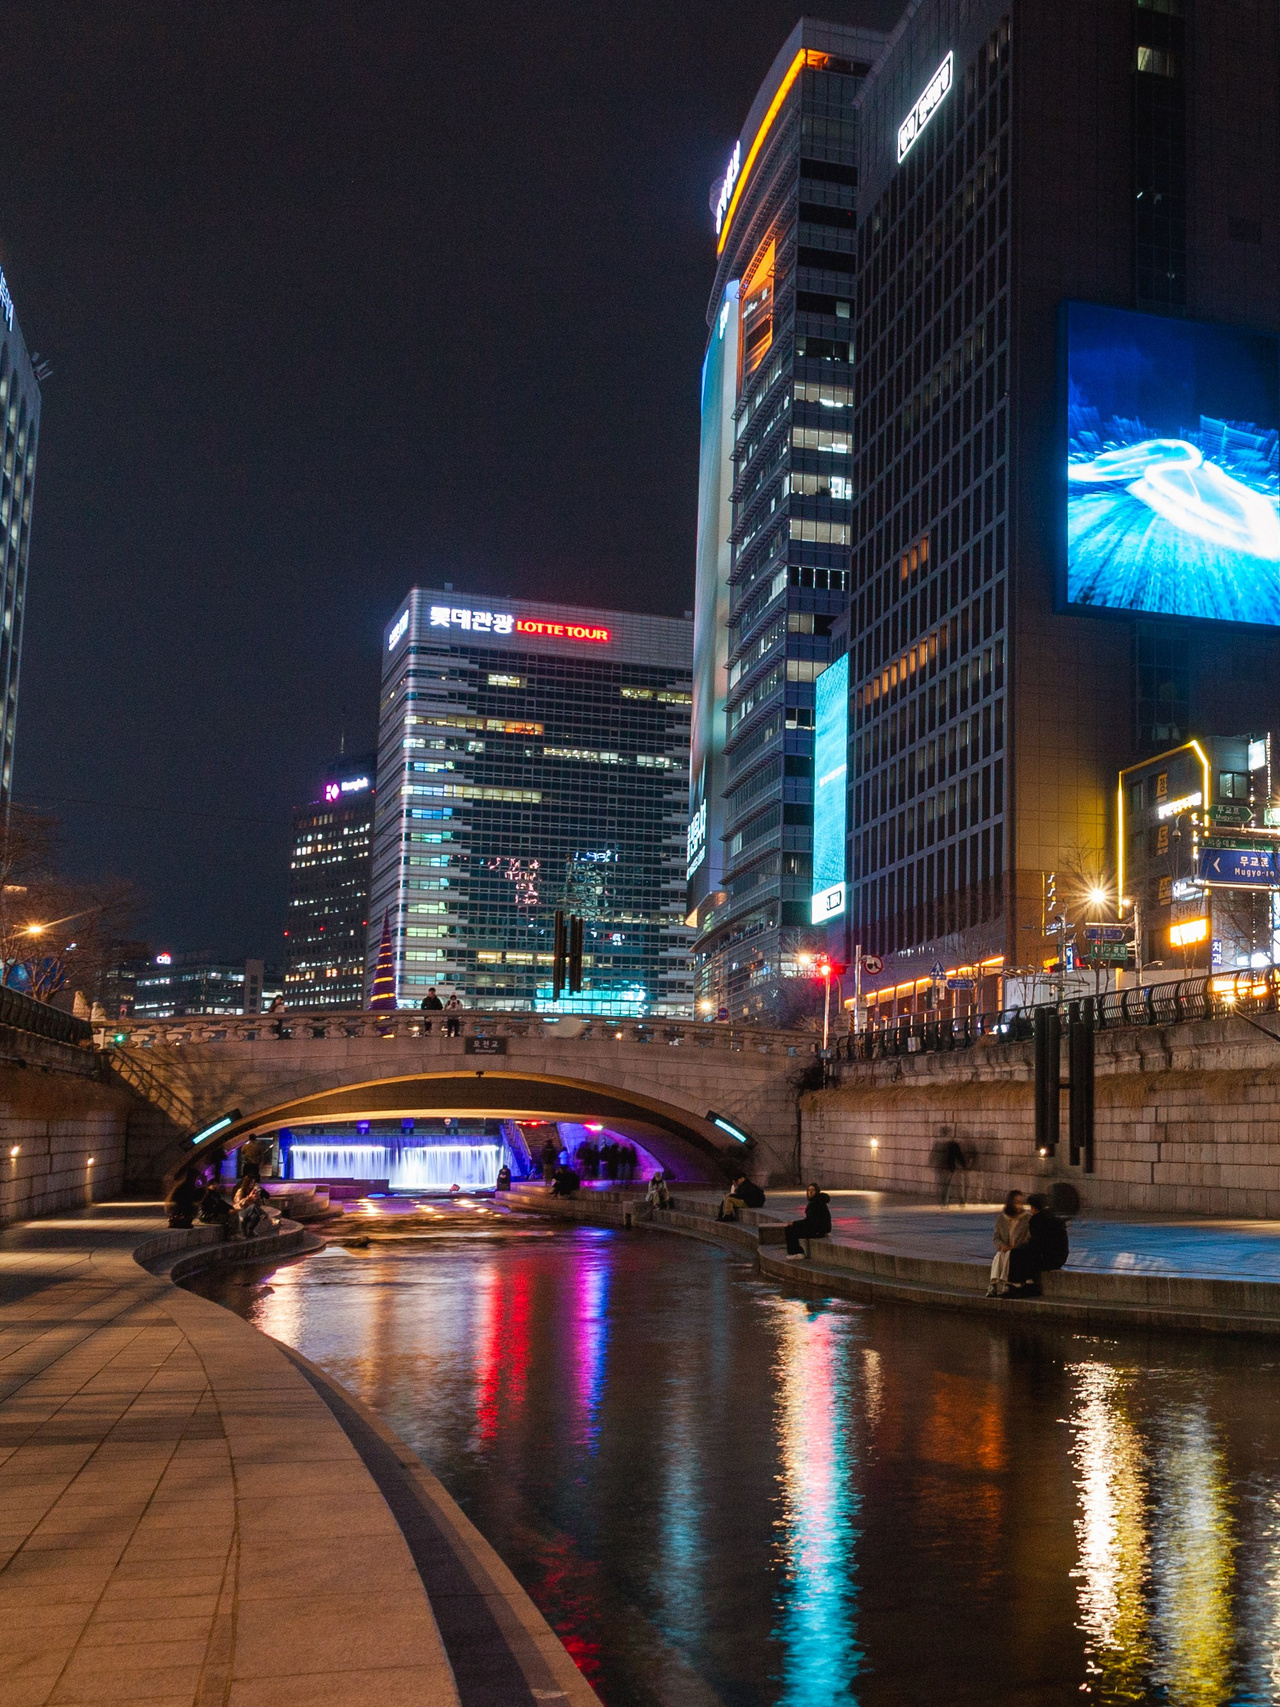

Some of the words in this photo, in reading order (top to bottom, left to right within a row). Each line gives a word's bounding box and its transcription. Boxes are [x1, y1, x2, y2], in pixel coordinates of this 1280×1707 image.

[430, 606, 515, 634] 롯데관광
[516, 620, 563, 636] LOTTE
[566, 625, 608, 640] TOUR
[1217, 806, 1239, 814] 무교로
[1239, 856, 1270, 868] 무교로
[1212, 941, 1222, 965] 치과
[473, 1040, 499, 1049] 모전교
